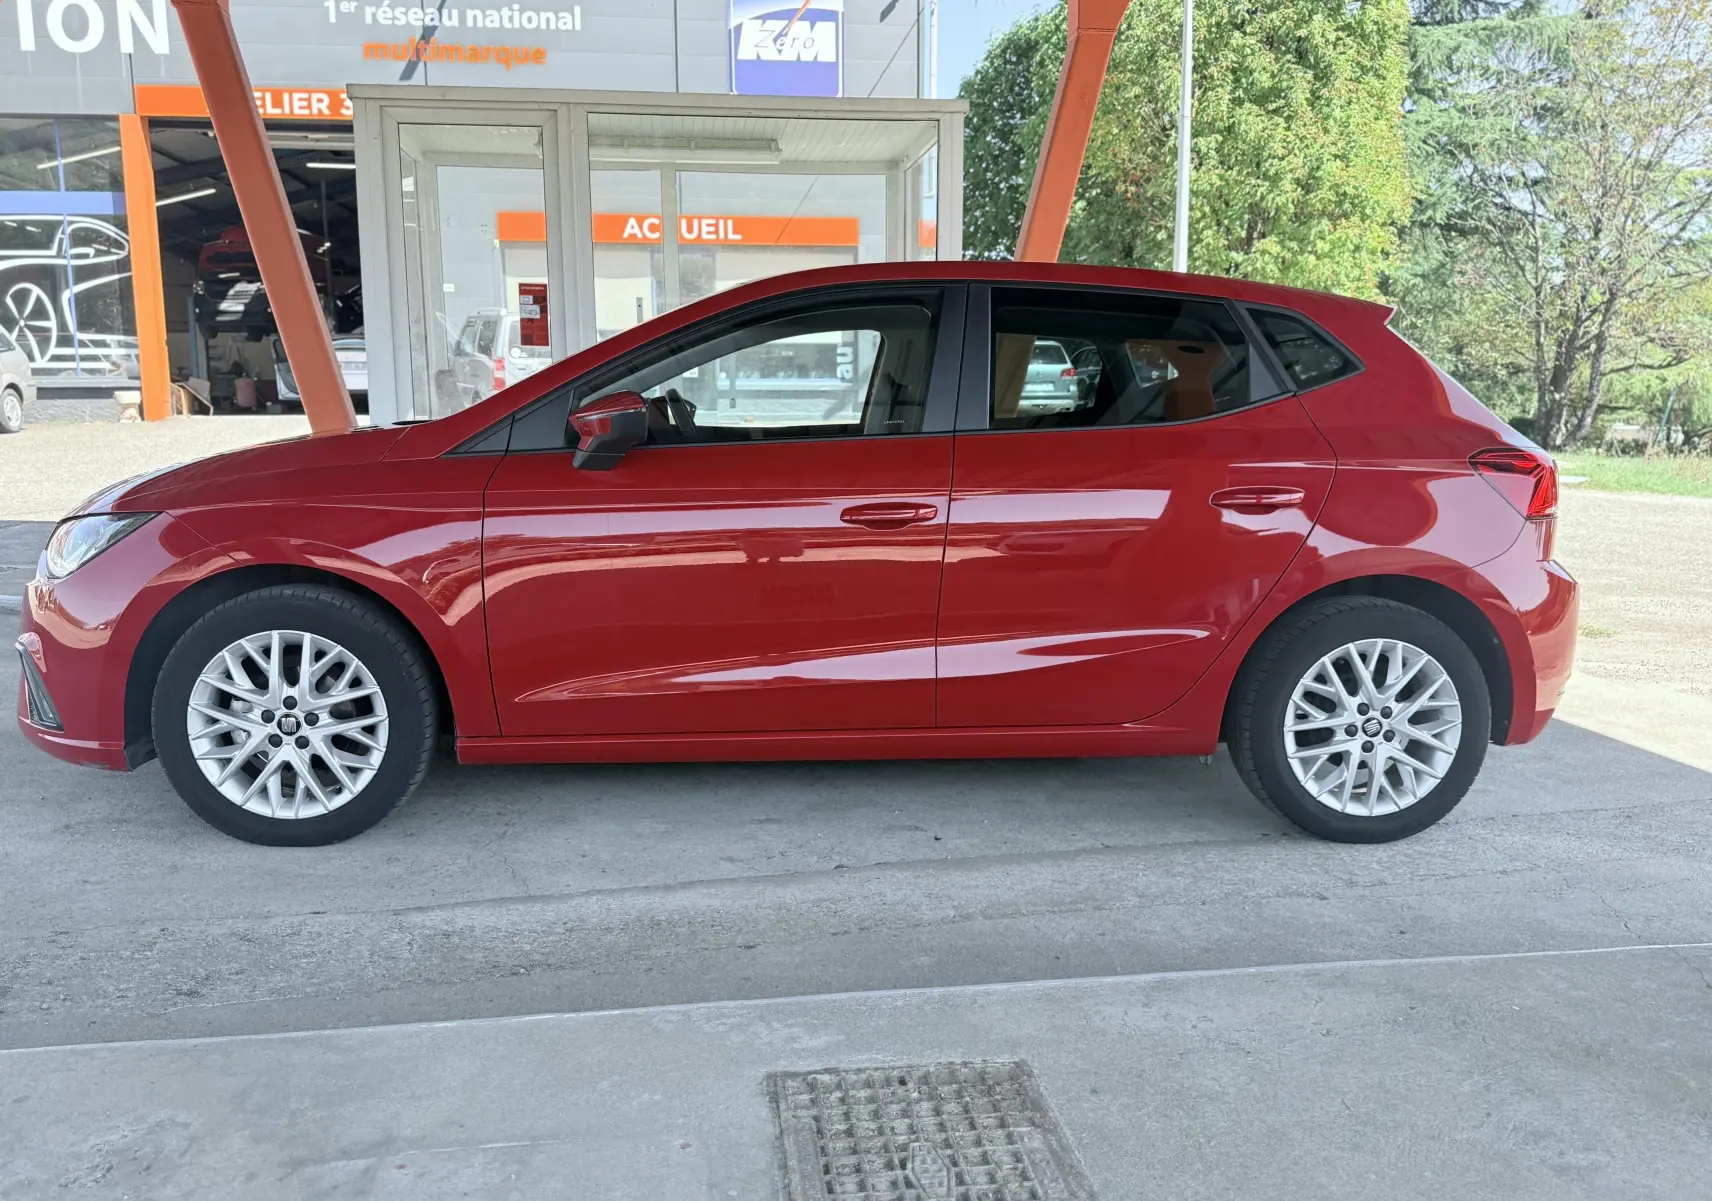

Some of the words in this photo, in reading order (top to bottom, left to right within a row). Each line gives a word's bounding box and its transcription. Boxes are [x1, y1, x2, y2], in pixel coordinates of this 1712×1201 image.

[16, 0, 170, 54] ION
[364, 0, 459, 27] réseau
[466, 5, 582, 31] national
[363, 36, 547, 69] multimarque
[206, 91, 331, 116] ELIER
[622, 216, 743, 240] ACUEIL
